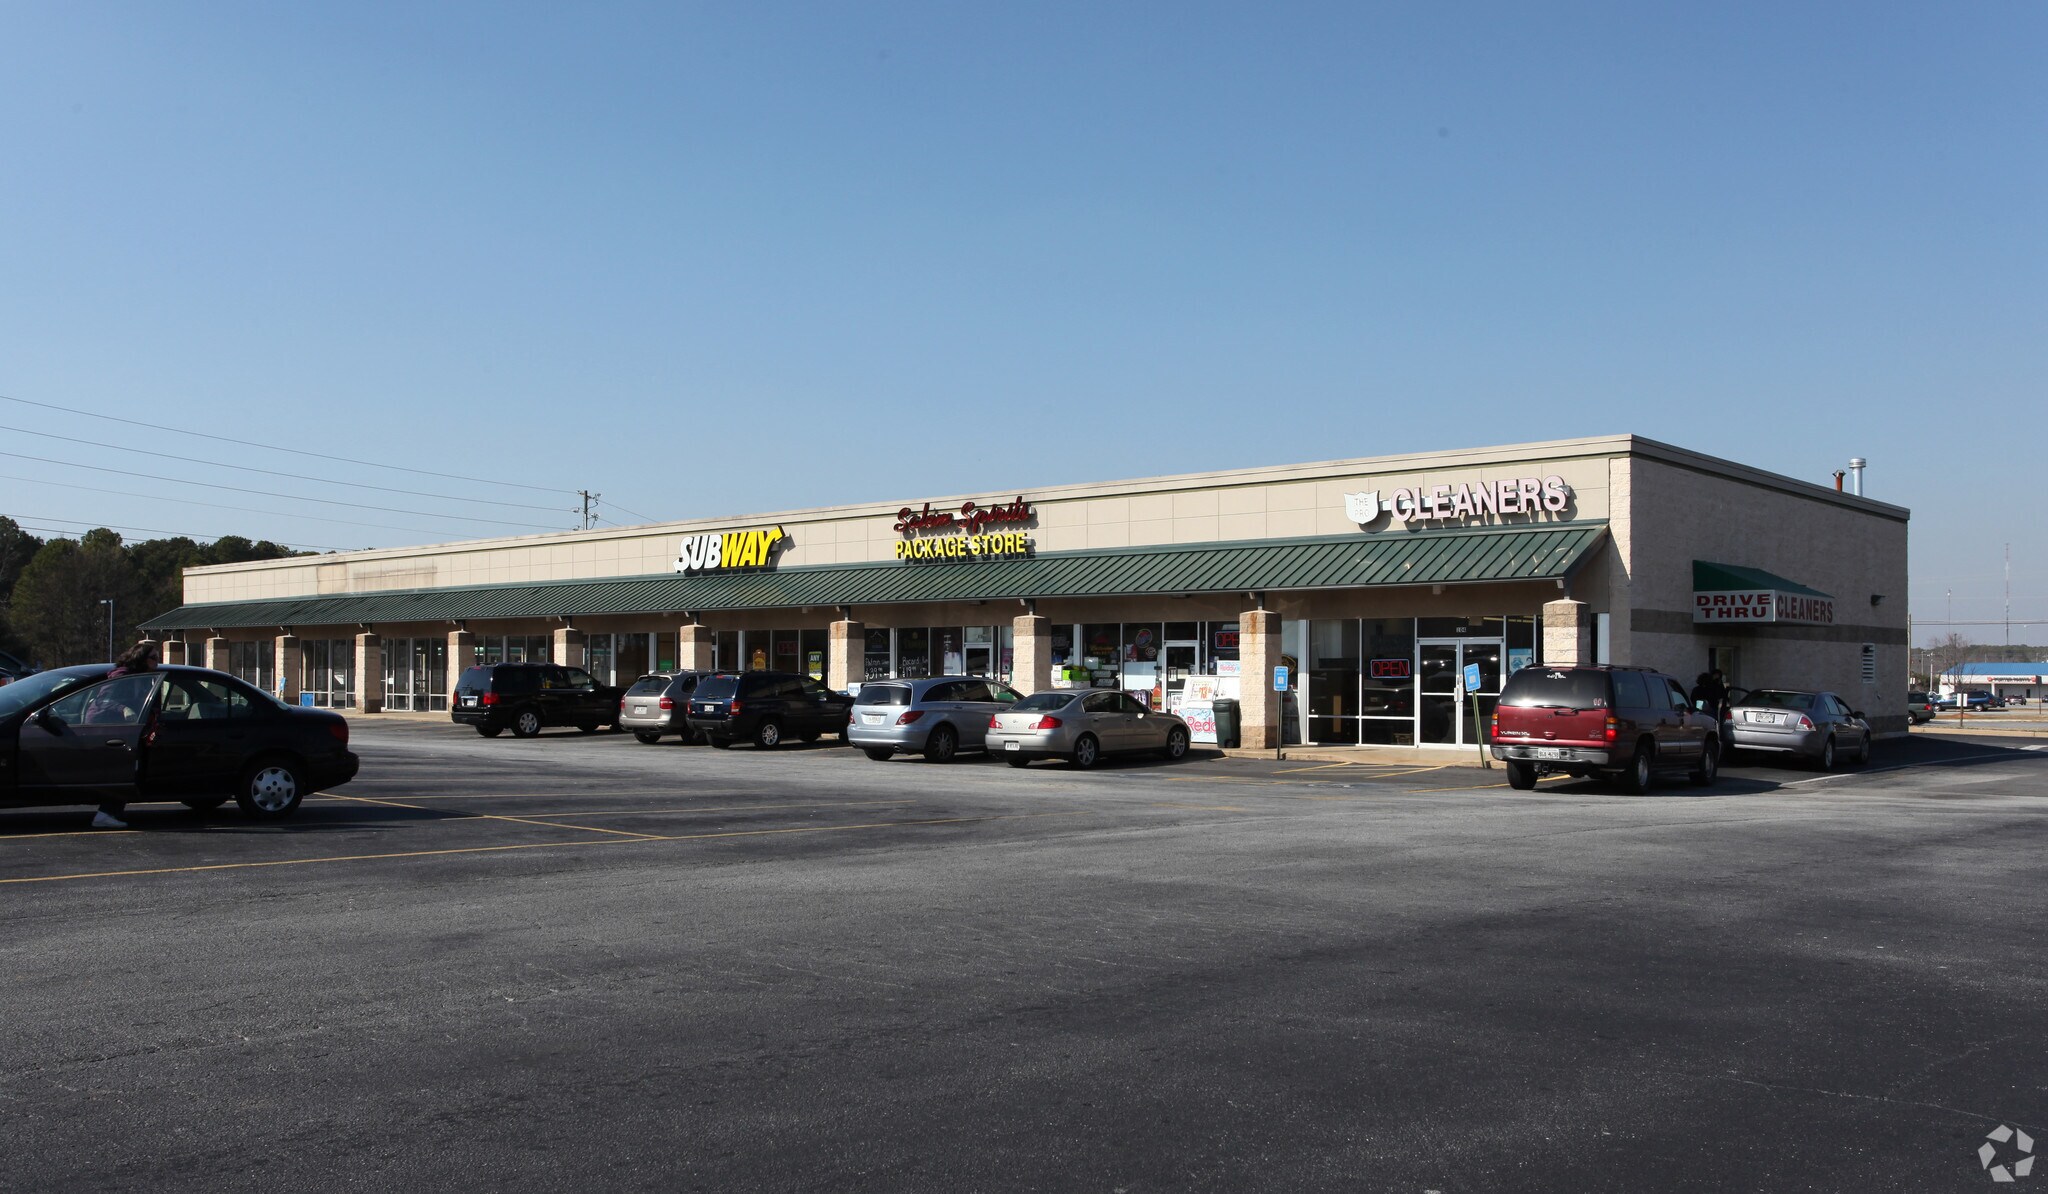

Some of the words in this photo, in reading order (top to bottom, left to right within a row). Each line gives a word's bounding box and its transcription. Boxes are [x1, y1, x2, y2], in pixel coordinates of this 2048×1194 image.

[1354, 498, 1368, 506] THE
[1391, 475, 1566, 522] CLEANERS
[893, 503, 954, 532] Salem
[957, 496, 1029, 534] Spirits
[1355, 509, 1369, 517] PRO
[673, 525, 783, 573] SUBWAY
[895, 537, 967, 559] PACKAGE
[971, 533, 1026, 555] STORE
[1697, 594, 1771, 606] DRIVE
[1701, 607, 1767, 618] THRU
[1777, 595, 1834, 623] CLEANERS
[1216, 633, 1239, 647] OPE
[1372, 660, 1409, 677] OPEN
[1187, 716, 1217, 733] Red
